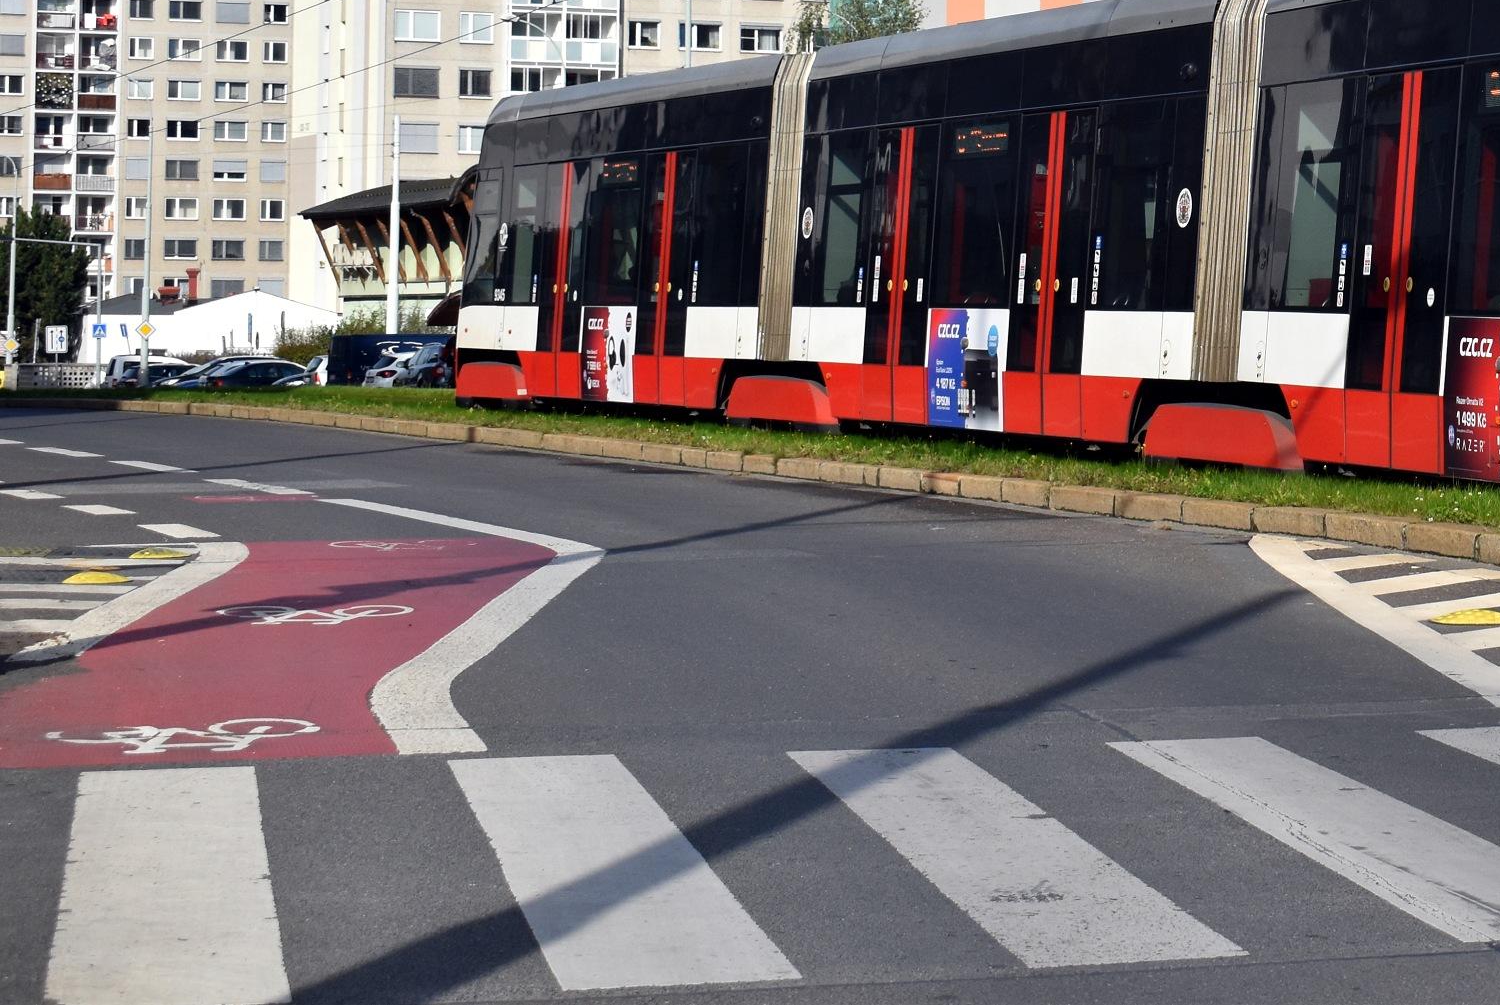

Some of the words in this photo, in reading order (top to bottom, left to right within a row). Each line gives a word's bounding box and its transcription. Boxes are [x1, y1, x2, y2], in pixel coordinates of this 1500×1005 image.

[1459, 336, 1494, 359] CZC.CZ
[1461, 411, 1476, 428] 499
[1477, 412, 1487, 429] Kč
